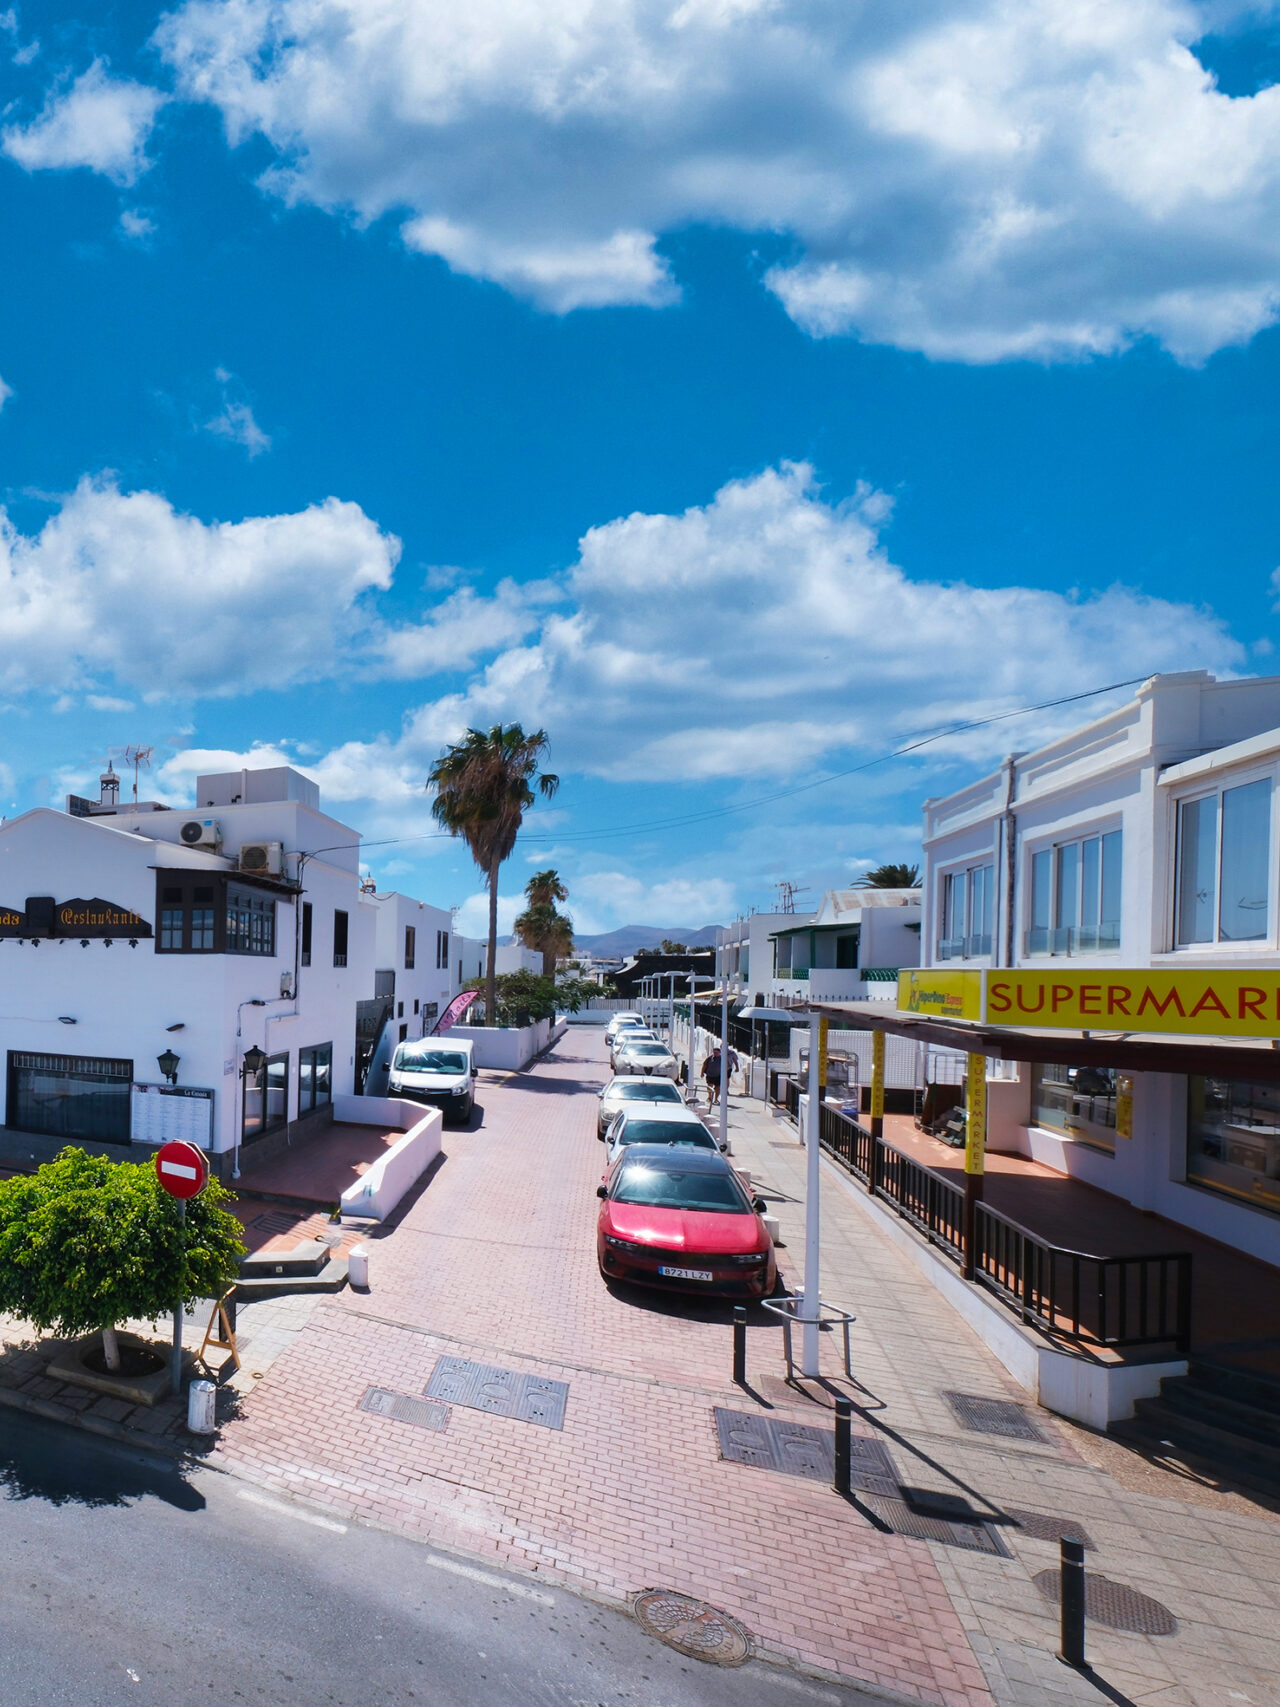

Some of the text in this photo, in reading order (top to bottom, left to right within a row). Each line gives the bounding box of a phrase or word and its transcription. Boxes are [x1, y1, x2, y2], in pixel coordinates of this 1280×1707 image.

[990, 982, 1280, 1021] SUPERMAR
[971, 1056, 983, 1170] SUPERMARKET
[664, 1268, 711, 1280] 8721 LZY
